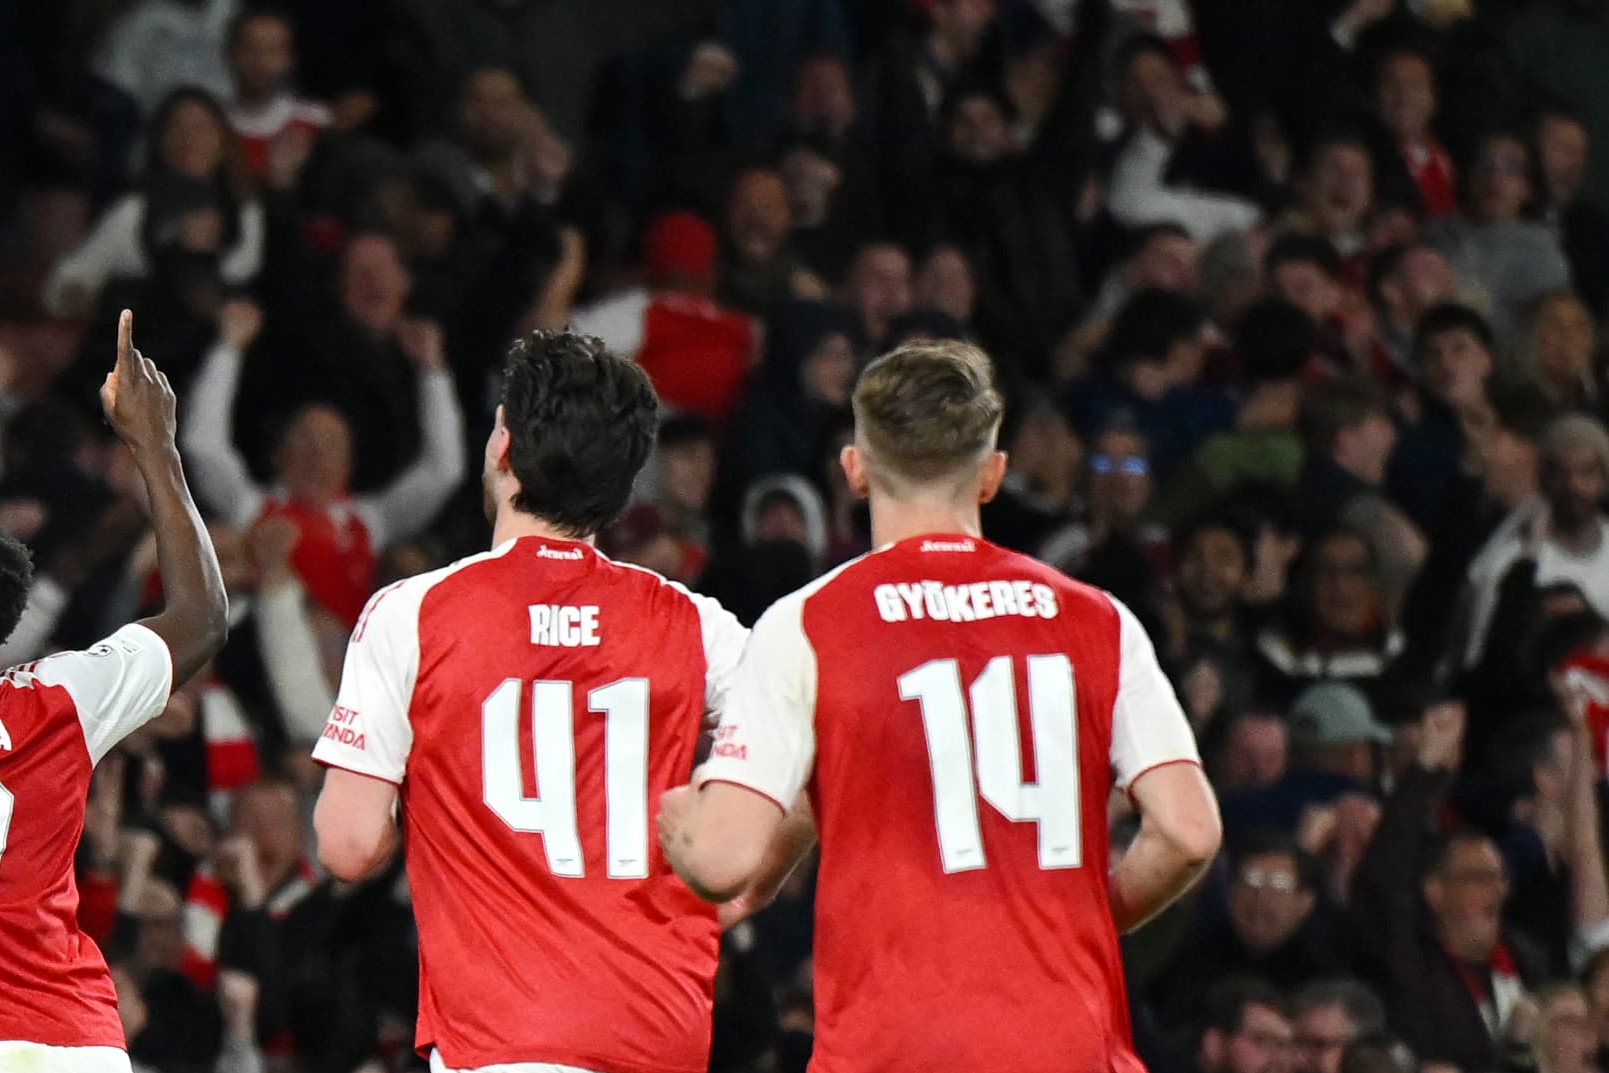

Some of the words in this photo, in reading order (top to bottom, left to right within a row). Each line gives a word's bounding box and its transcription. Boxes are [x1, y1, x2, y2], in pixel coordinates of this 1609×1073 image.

[874, 580, 1059, 622] GYÖKERES
[528, 604, 601, 647] RICE
[333, 705, 359, 725] SIT
[323, 723, 365, 751] ANDA
[481, 677, 650, 879] 41
[896, 653, 1083, 874] 14
